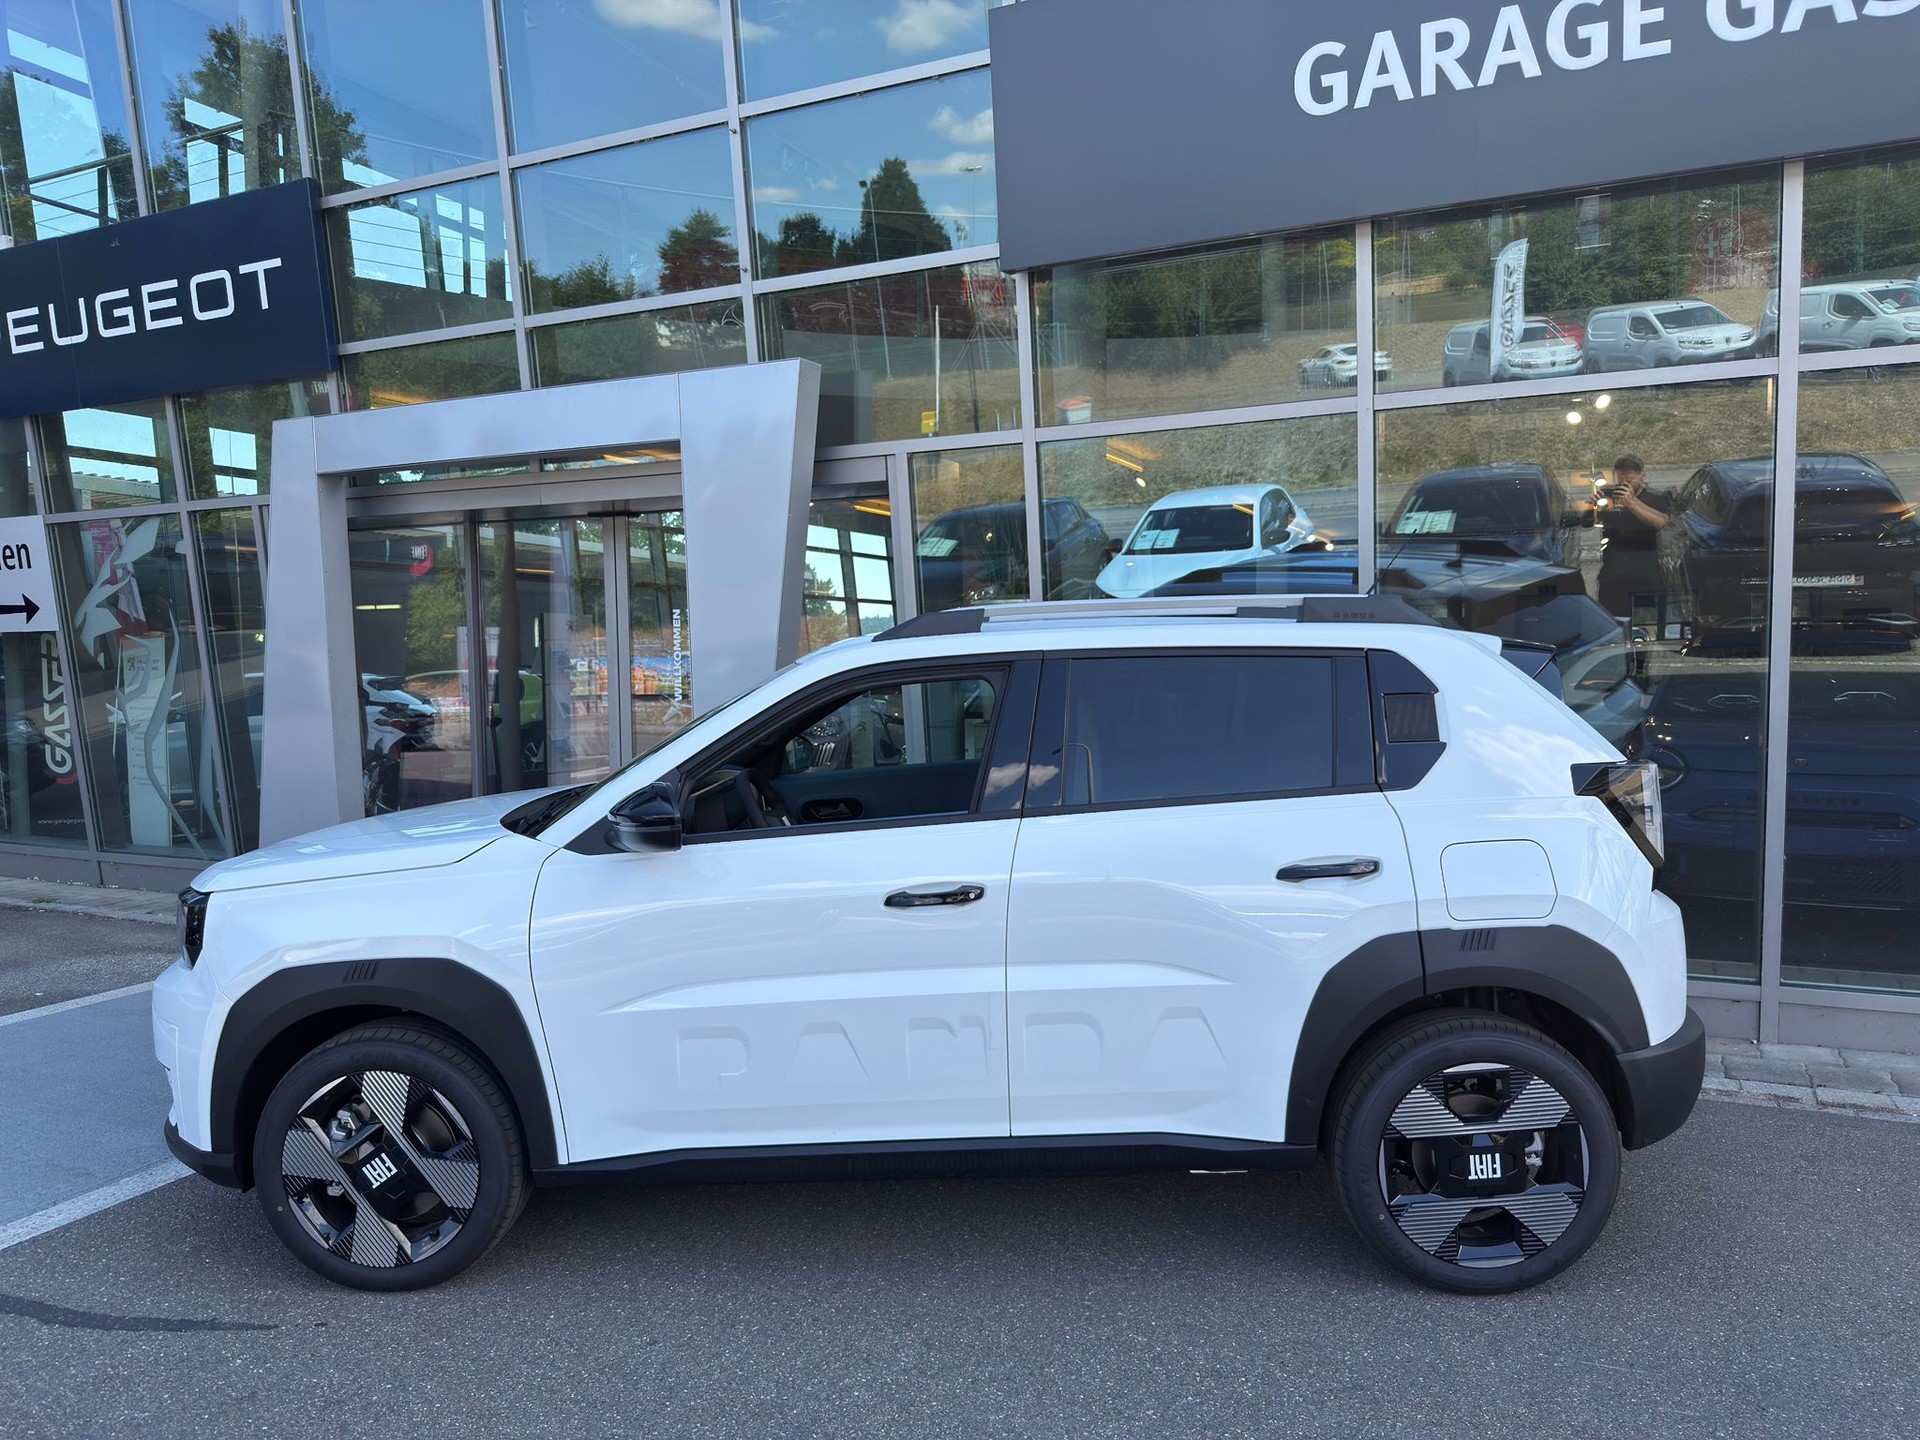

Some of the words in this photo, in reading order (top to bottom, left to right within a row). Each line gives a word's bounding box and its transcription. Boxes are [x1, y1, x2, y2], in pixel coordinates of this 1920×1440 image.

[1293, 0, 1672, 117] GARAGE
[0, 257, 283, 355] EUGEOT
[0, 542, 32, 571] en
[672, 608, 683, 702] WILLKOMMEN
[676, 1005, 1230, 1092] PANDA
[362, 1152, 398, 1189] FIAT
[1467, 1152, 1502, 1181] FIAT
